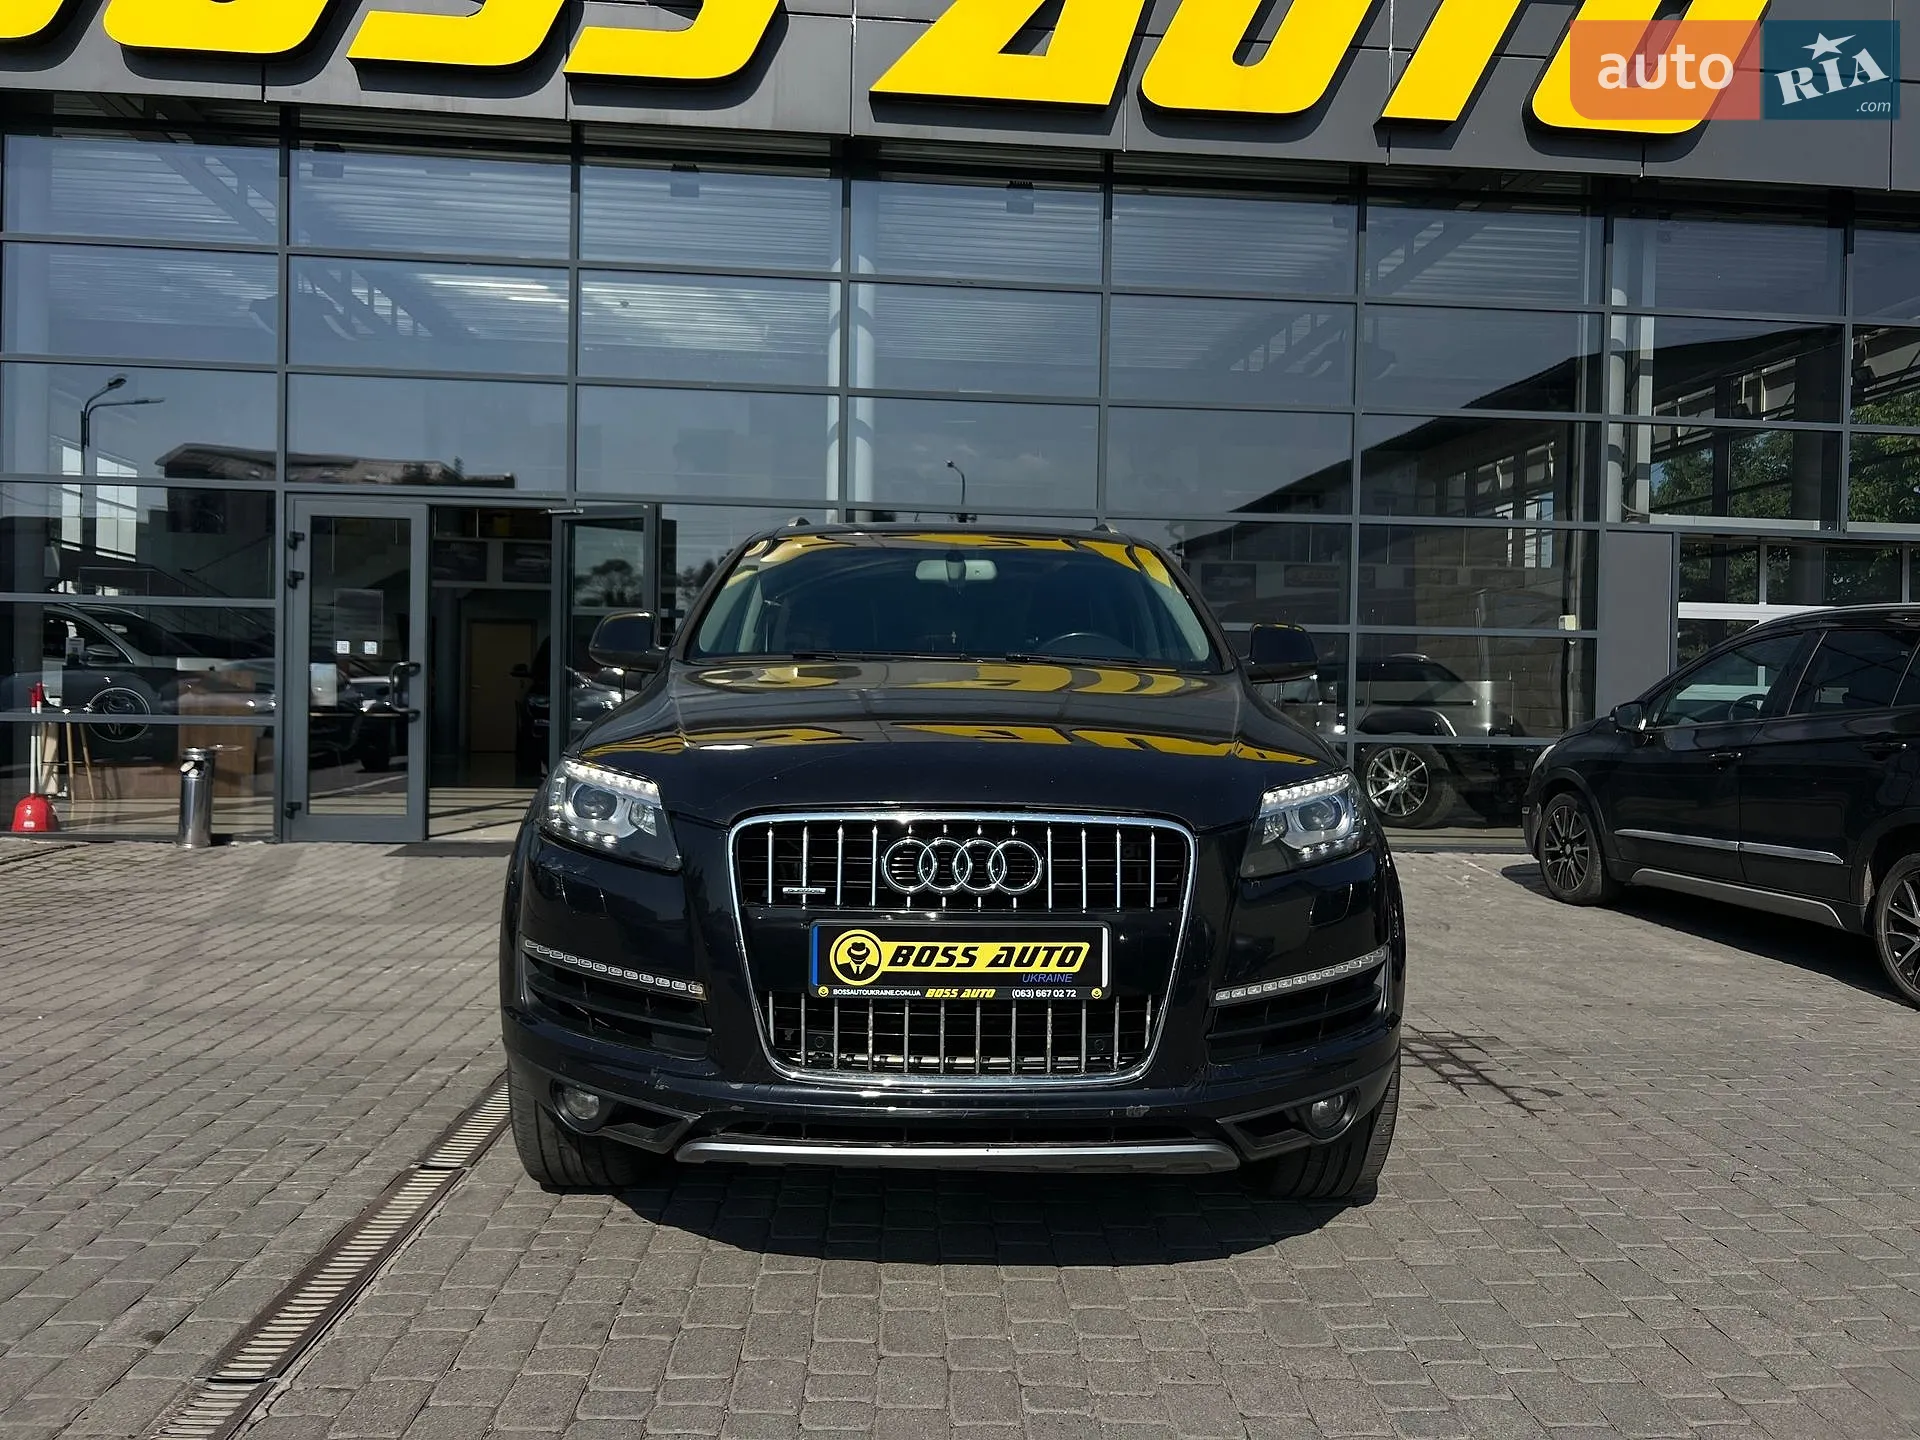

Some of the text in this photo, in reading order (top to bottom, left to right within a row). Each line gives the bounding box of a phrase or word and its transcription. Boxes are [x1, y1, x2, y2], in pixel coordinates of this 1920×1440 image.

[887, 945, 1084, 968] BOSS AUTO
[1022, 973, 1073, 983] UKRAINE
[925, 988, 997, 998] BOSS AUTO
[1011, 989, 1077, 998] (063) 667 02 72
